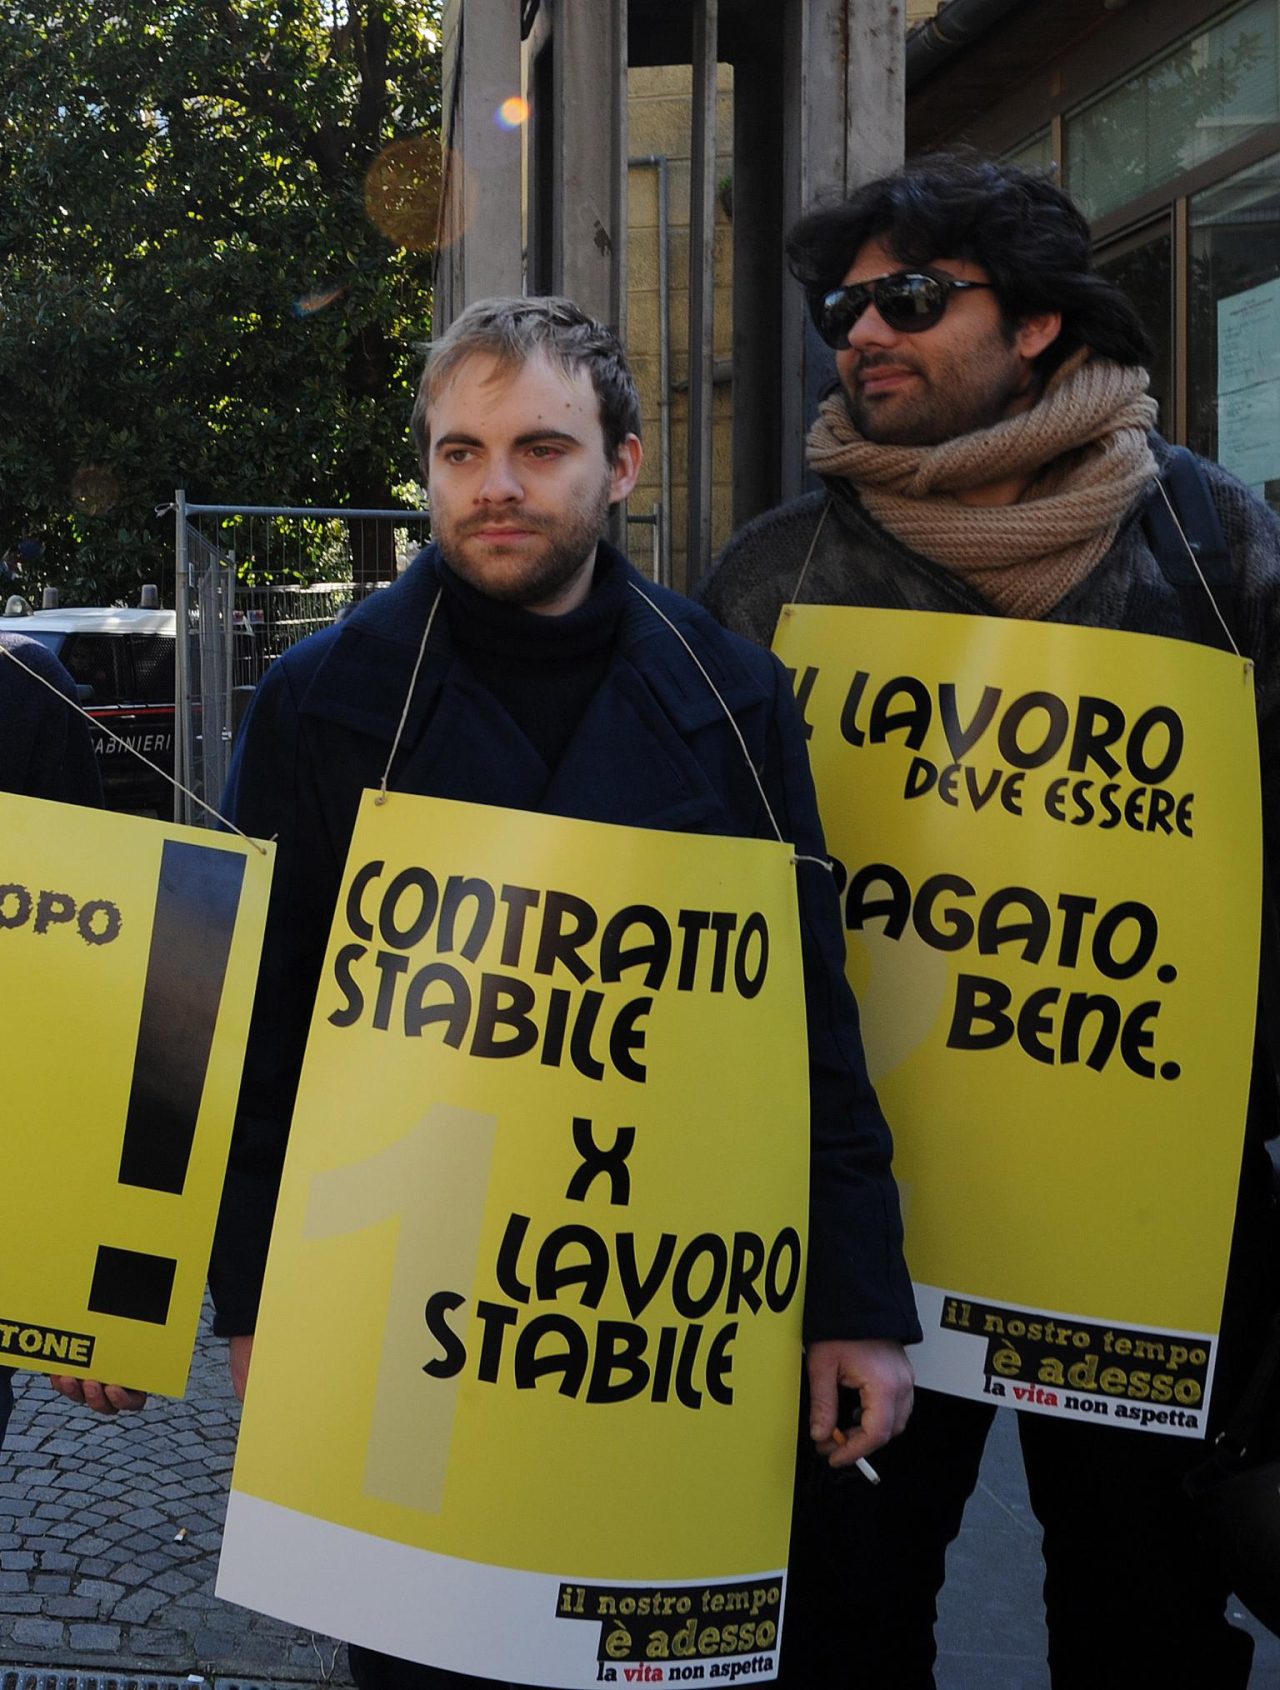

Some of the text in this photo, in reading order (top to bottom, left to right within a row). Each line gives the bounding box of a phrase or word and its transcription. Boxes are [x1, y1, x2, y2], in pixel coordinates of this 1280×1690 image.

[840, 670, 1185, 786] LAVORO
[904, 762, 1194, 838] DEVE ESSERE
[347, 861, 769, 999] CONTRATTO
[328, 944, 653, 1083] STABILE
[946, 973, 1181, 1081] BENE.
[496, 1212, 802, 1322] LAVORO
[422, 1291, 738, 1410] STABILE
[944, 1301, 1207, 1371] il nostro tempo
[992, 1338, 1202, 1405] è adesso
[983, 1375, 1199, 1430] la vita non aspetta
[560, 1586, 780, 1617] il nostro tempo
[605, 1617, 776, 1658] è adesso
[596, 1656, 773, 1682] la vita non aspetta
